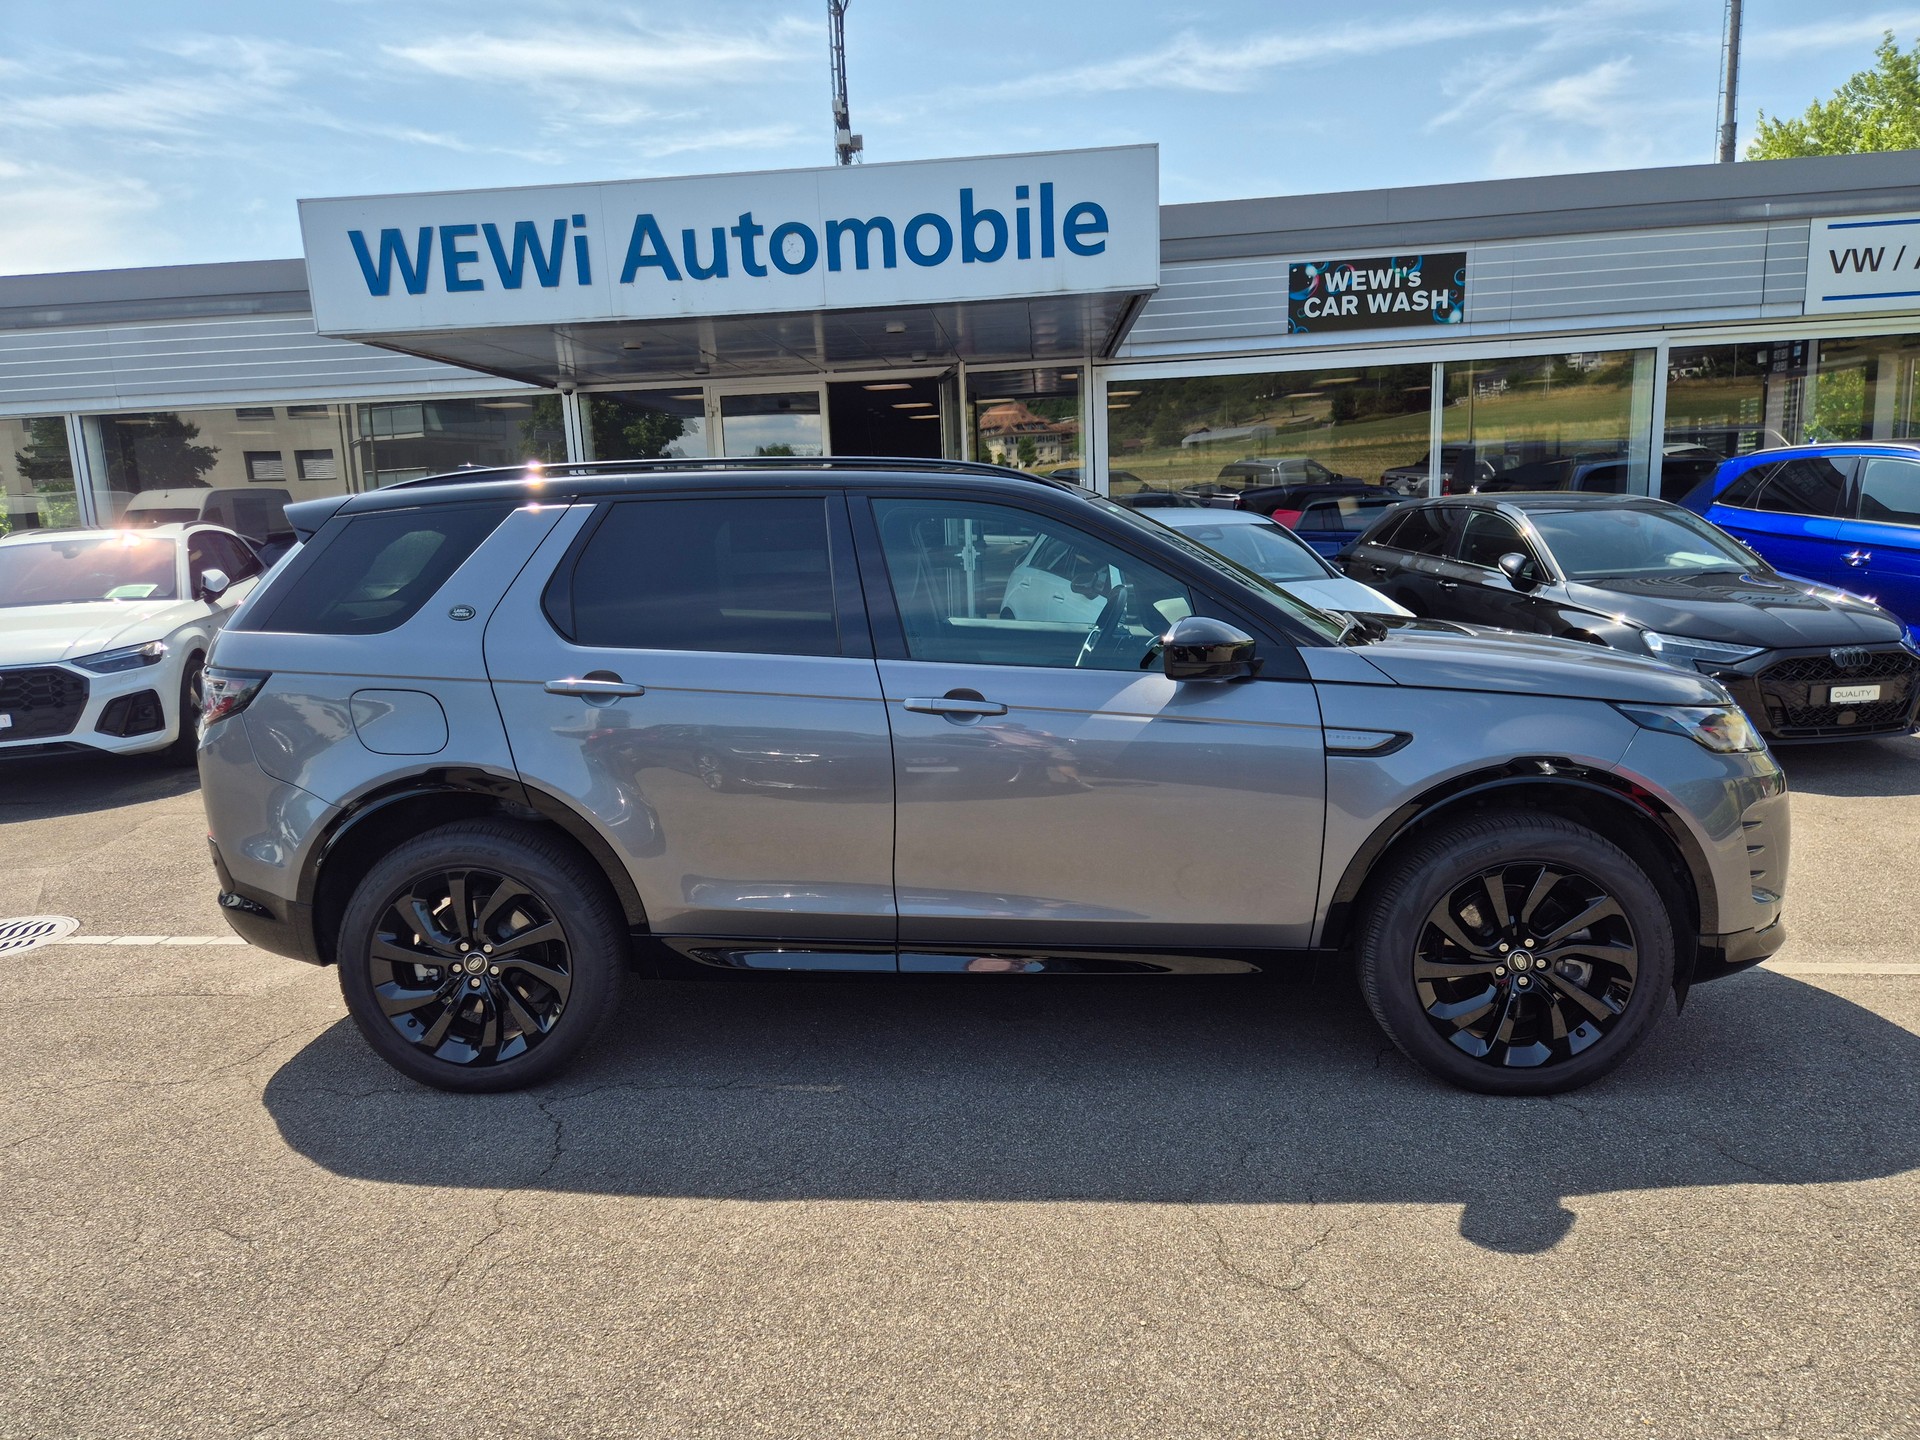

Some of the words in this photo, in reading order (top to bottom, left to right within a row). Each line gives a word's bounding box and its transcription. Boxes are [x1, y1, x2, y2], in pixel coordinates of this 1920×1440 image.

[348, 213, 592, 297] WEWi
[620, 182, 1109, 284] Automobile
[1829, 246, 1886, 274] VW
[1324, 266, 1422, 293] WEWi's
[1303, 295, 1359, 318] CAR
[1366, 289, 1449, 314] WASH
